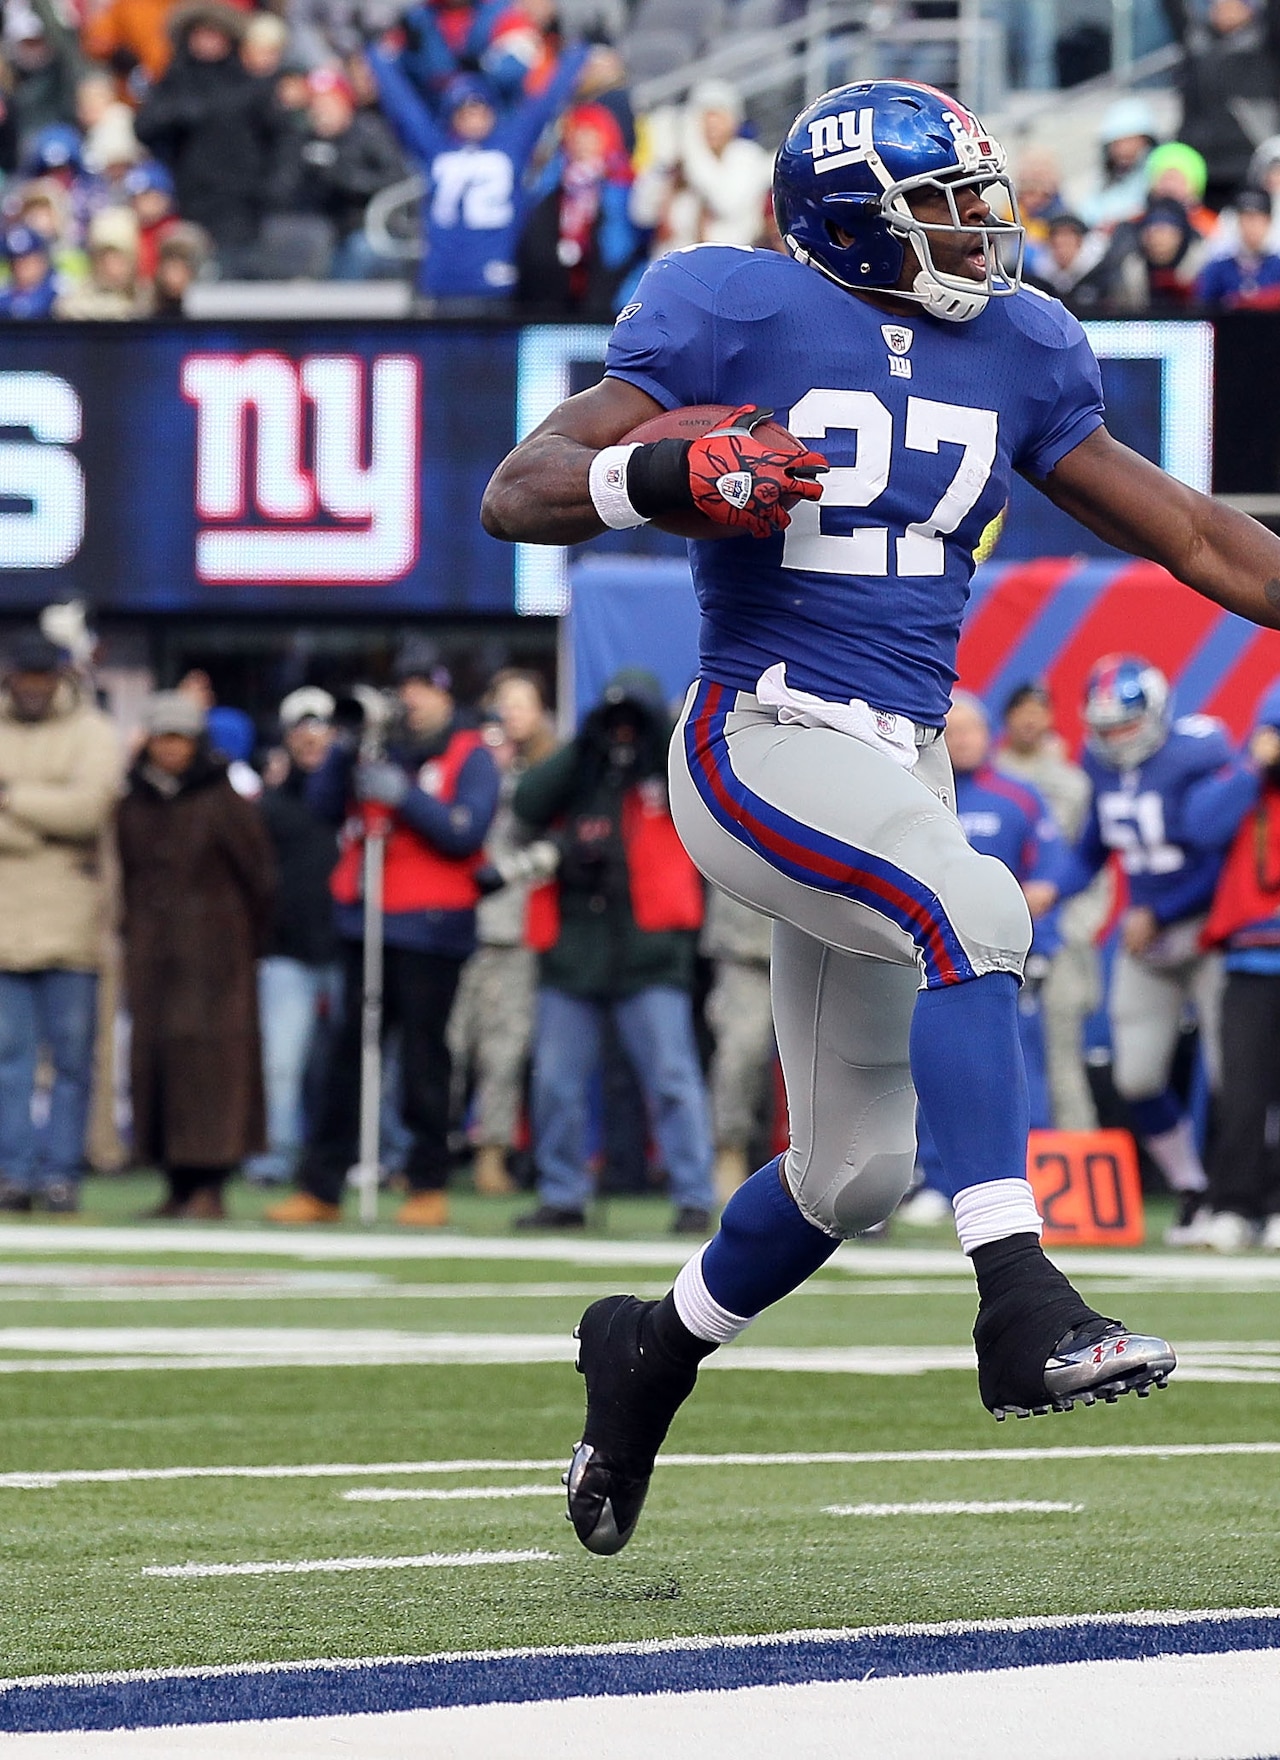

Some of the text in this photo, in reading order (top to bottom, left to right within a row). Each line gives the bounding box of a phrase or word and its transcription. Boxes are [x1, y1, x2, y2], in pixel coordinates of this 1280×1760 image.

[431, 149, 515, 230] 72
[780, 387, 999, 577] 27
[1097, 791, 1187, 875] 51
[1035, 1153, 1127, 1229] 20
